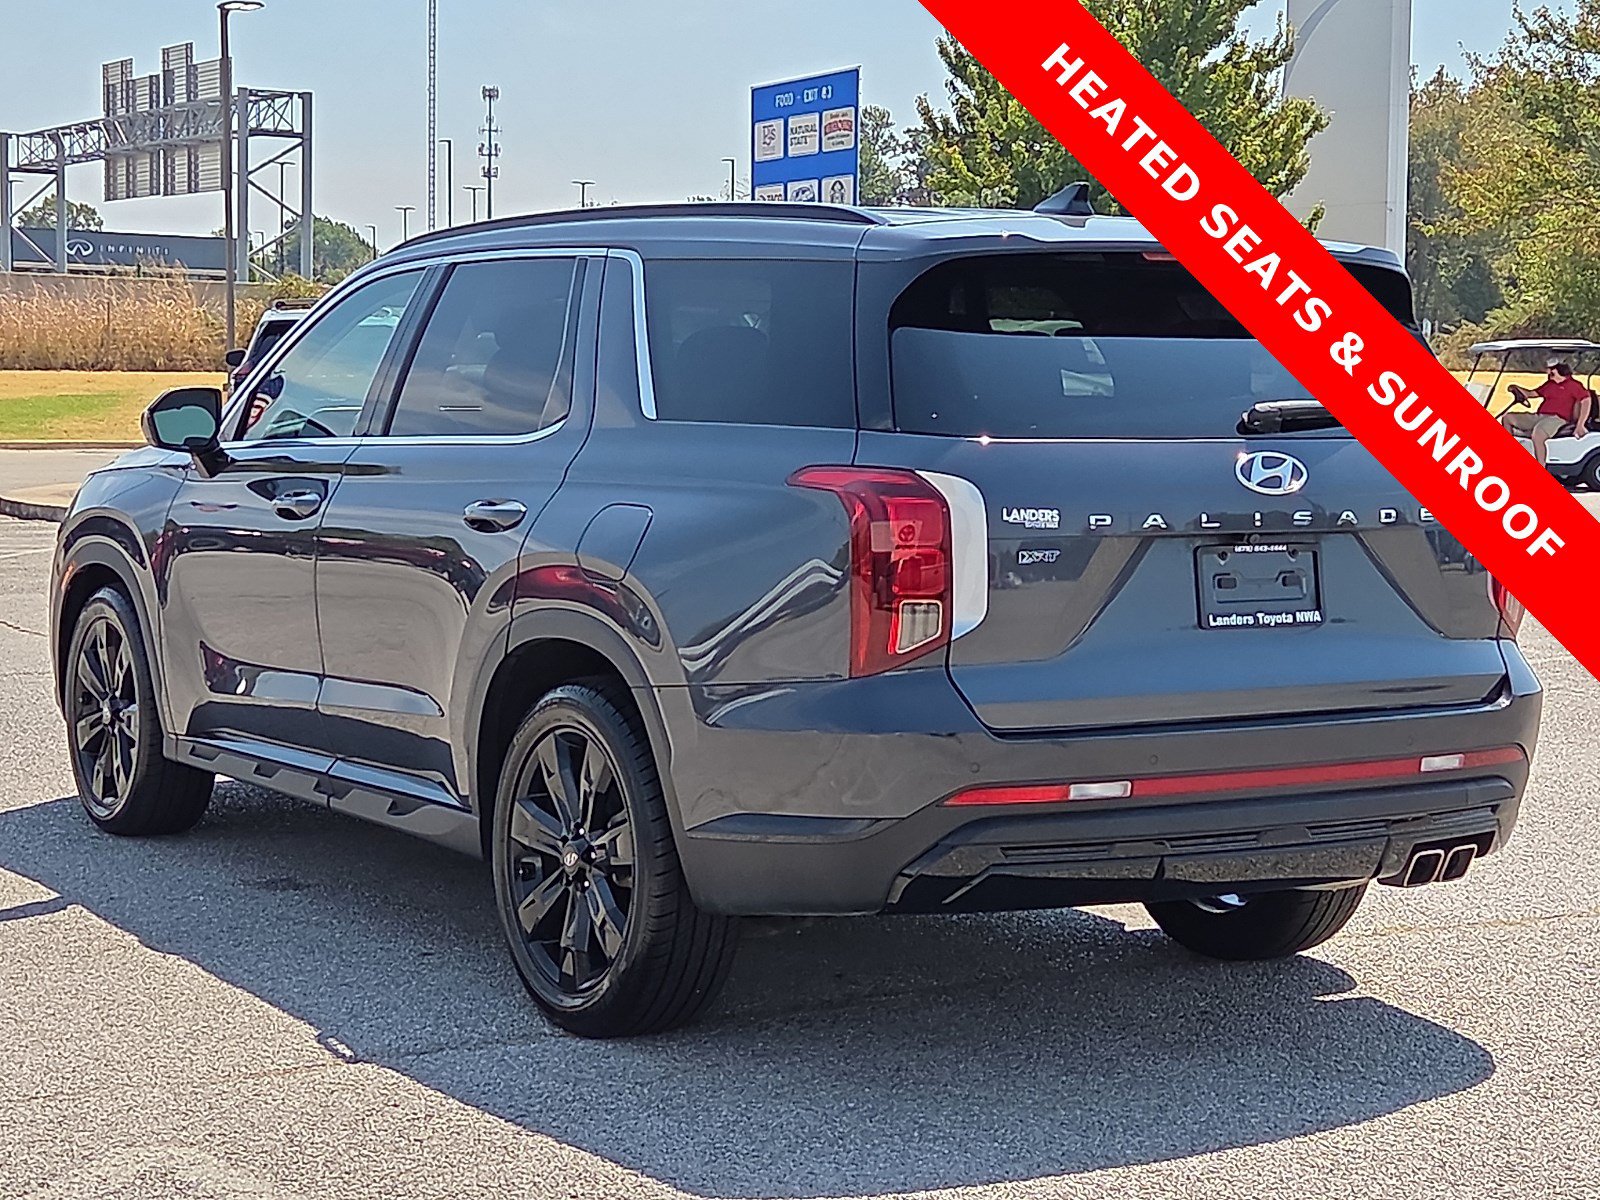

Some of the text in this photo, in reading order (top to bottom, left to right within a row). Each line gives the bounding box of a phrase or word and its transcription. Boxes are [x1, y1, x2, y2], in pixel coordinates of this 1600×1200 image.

[774, 92, 794, 108] FOOD
[803, 88, 819, 103] EXIT
[790, 123, 817, 136] NATURAL
[790, 135, 808, 146] STATE
[99, 244, 169, 256] INFINITI
[1002, 507, 1060, 522] LANDERS
[1088, 507, 1436, 530] PALISADE
[1209, 610, 1322, 627] Landers Toyota NWA
